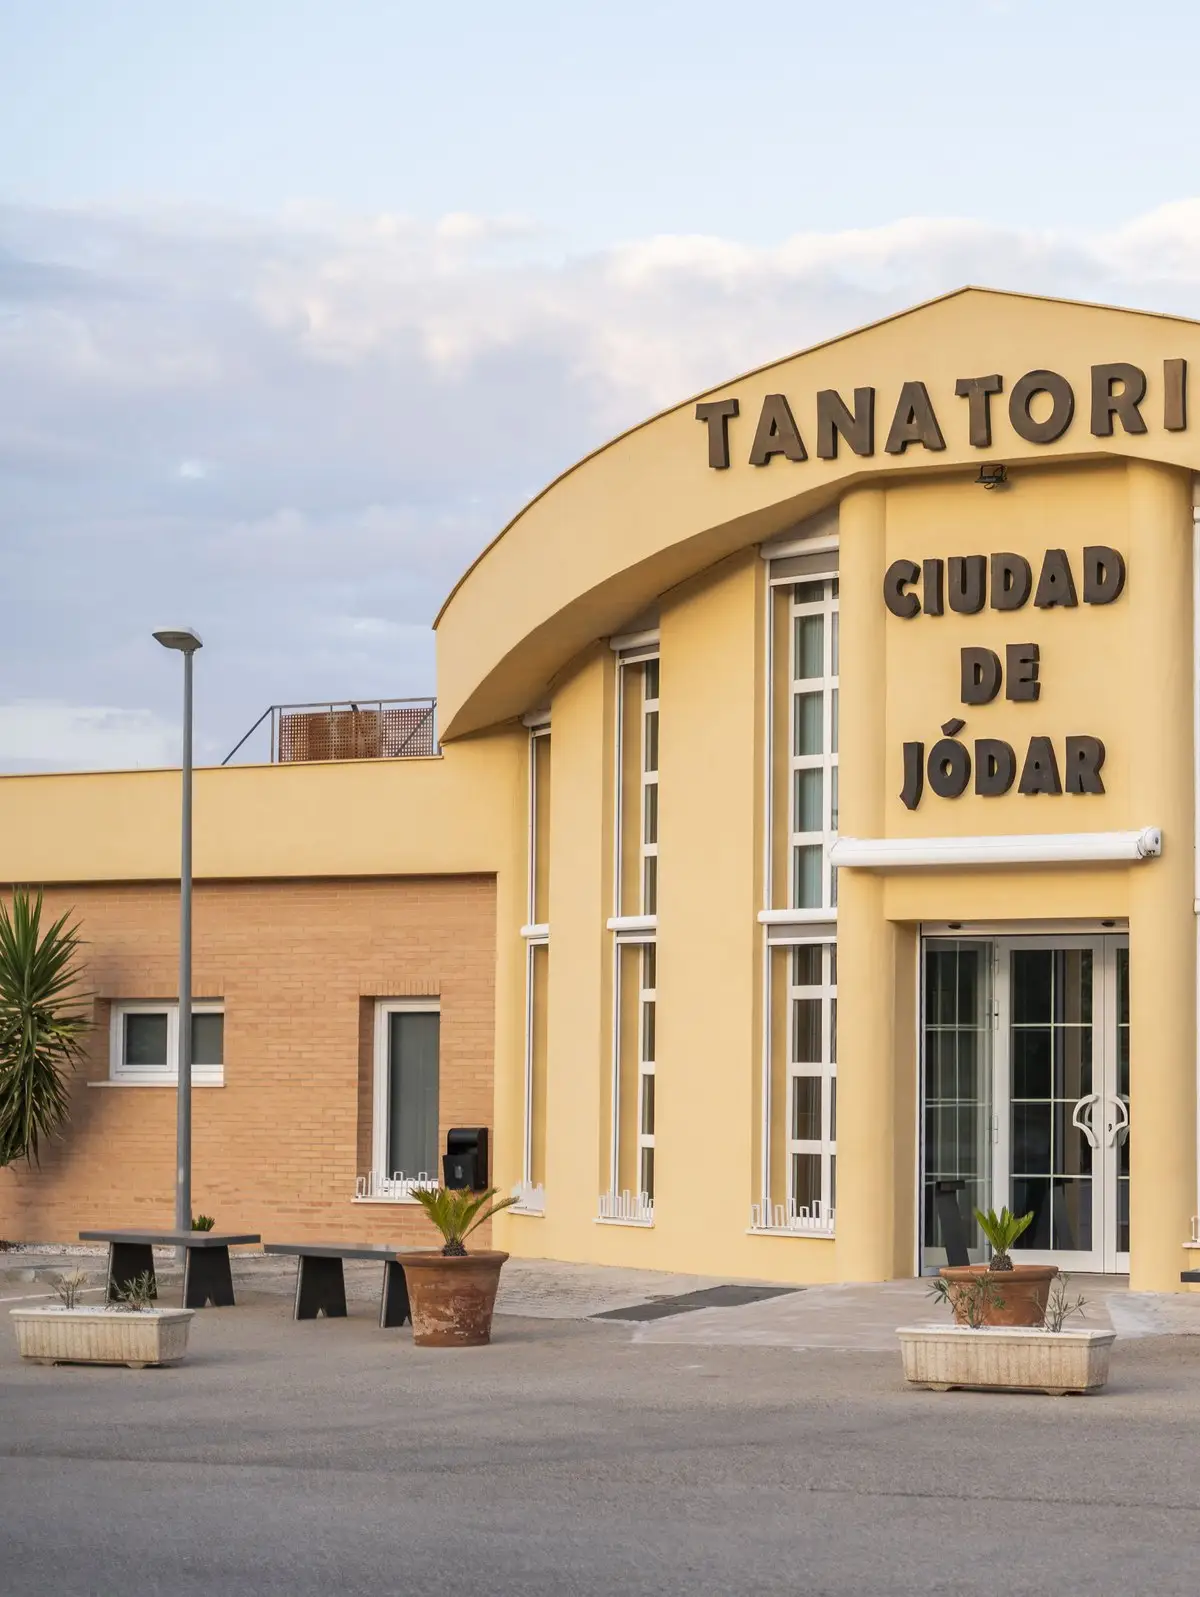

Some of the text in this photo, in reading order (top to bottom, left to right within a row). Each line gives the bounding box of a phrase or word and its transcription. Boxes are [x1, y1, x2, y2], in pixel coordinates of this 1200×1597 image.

[883, 545, 1126, 619] CIUDAD
[960, 642, 1042, 706] DE
[899, 717, 1106, 811] JÓDAR
